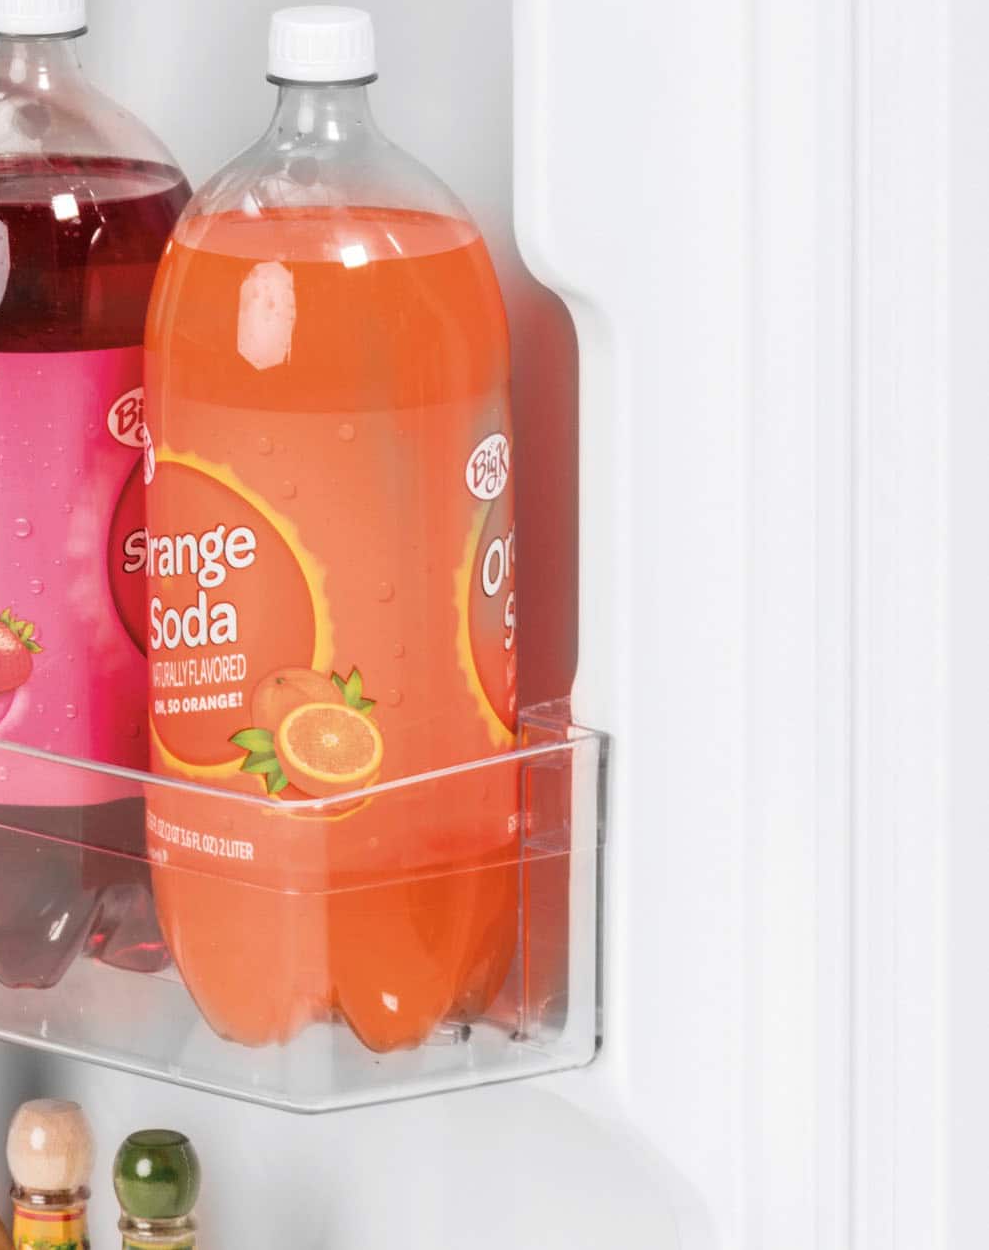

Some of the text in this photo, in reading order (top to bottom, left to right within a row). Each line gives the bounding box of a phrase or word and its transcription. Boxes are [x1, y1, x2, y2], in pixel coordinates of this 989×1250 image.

[145, 525, 257, 589] range
[149, 590, 239, 650] Soda
[188, 653, 247, 686] FLAVORED
[167, 698, 181, 715] SO
[181, 691, 244, 713] ORANGE!
[218, 837, 227, 857] 2
[226, 839, 254, 861] LITER
